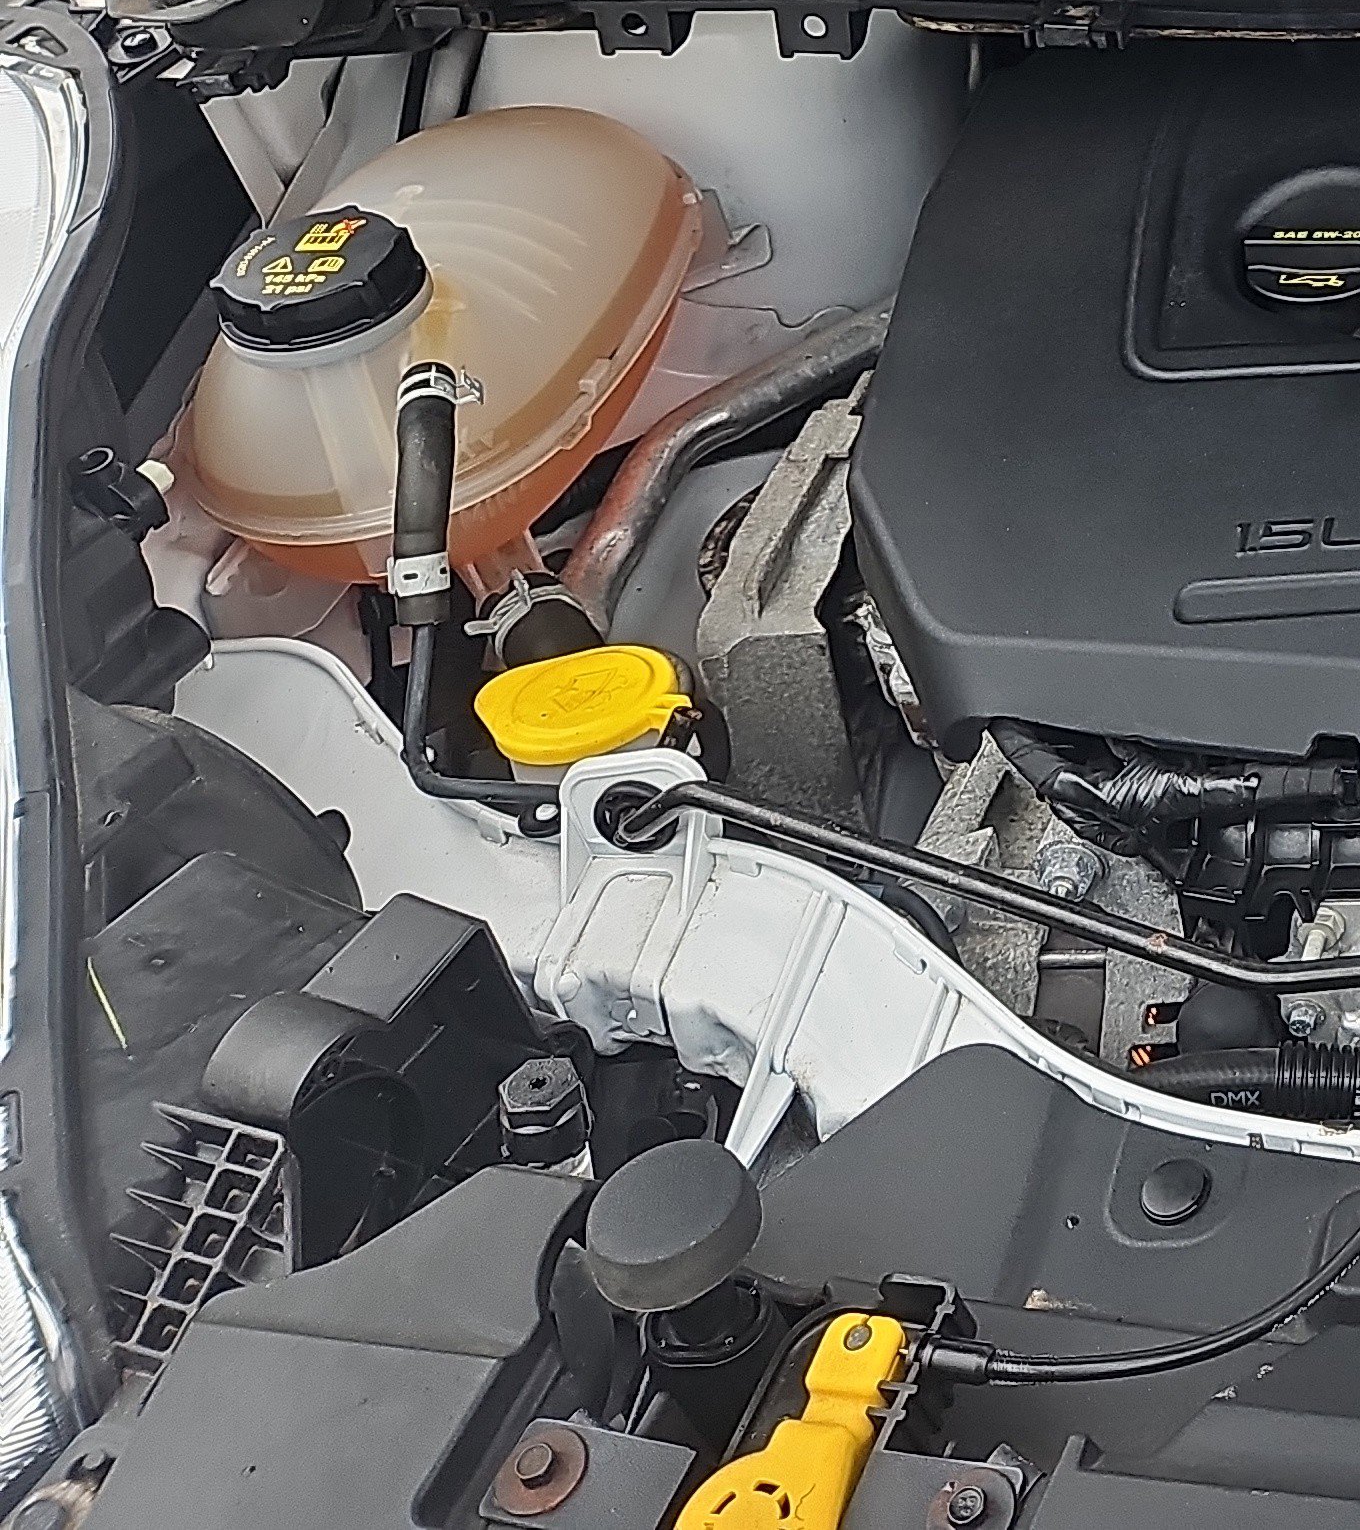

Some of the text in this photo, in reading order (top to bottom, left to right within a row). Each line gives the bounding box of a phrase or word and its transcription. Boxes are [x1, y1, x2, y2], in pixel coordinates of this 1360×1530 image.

[295, 274, 326, 283] kPa
[262, 284, 314, 295] 21 psi
[1210, 1090, 1260, 1107] DMX
